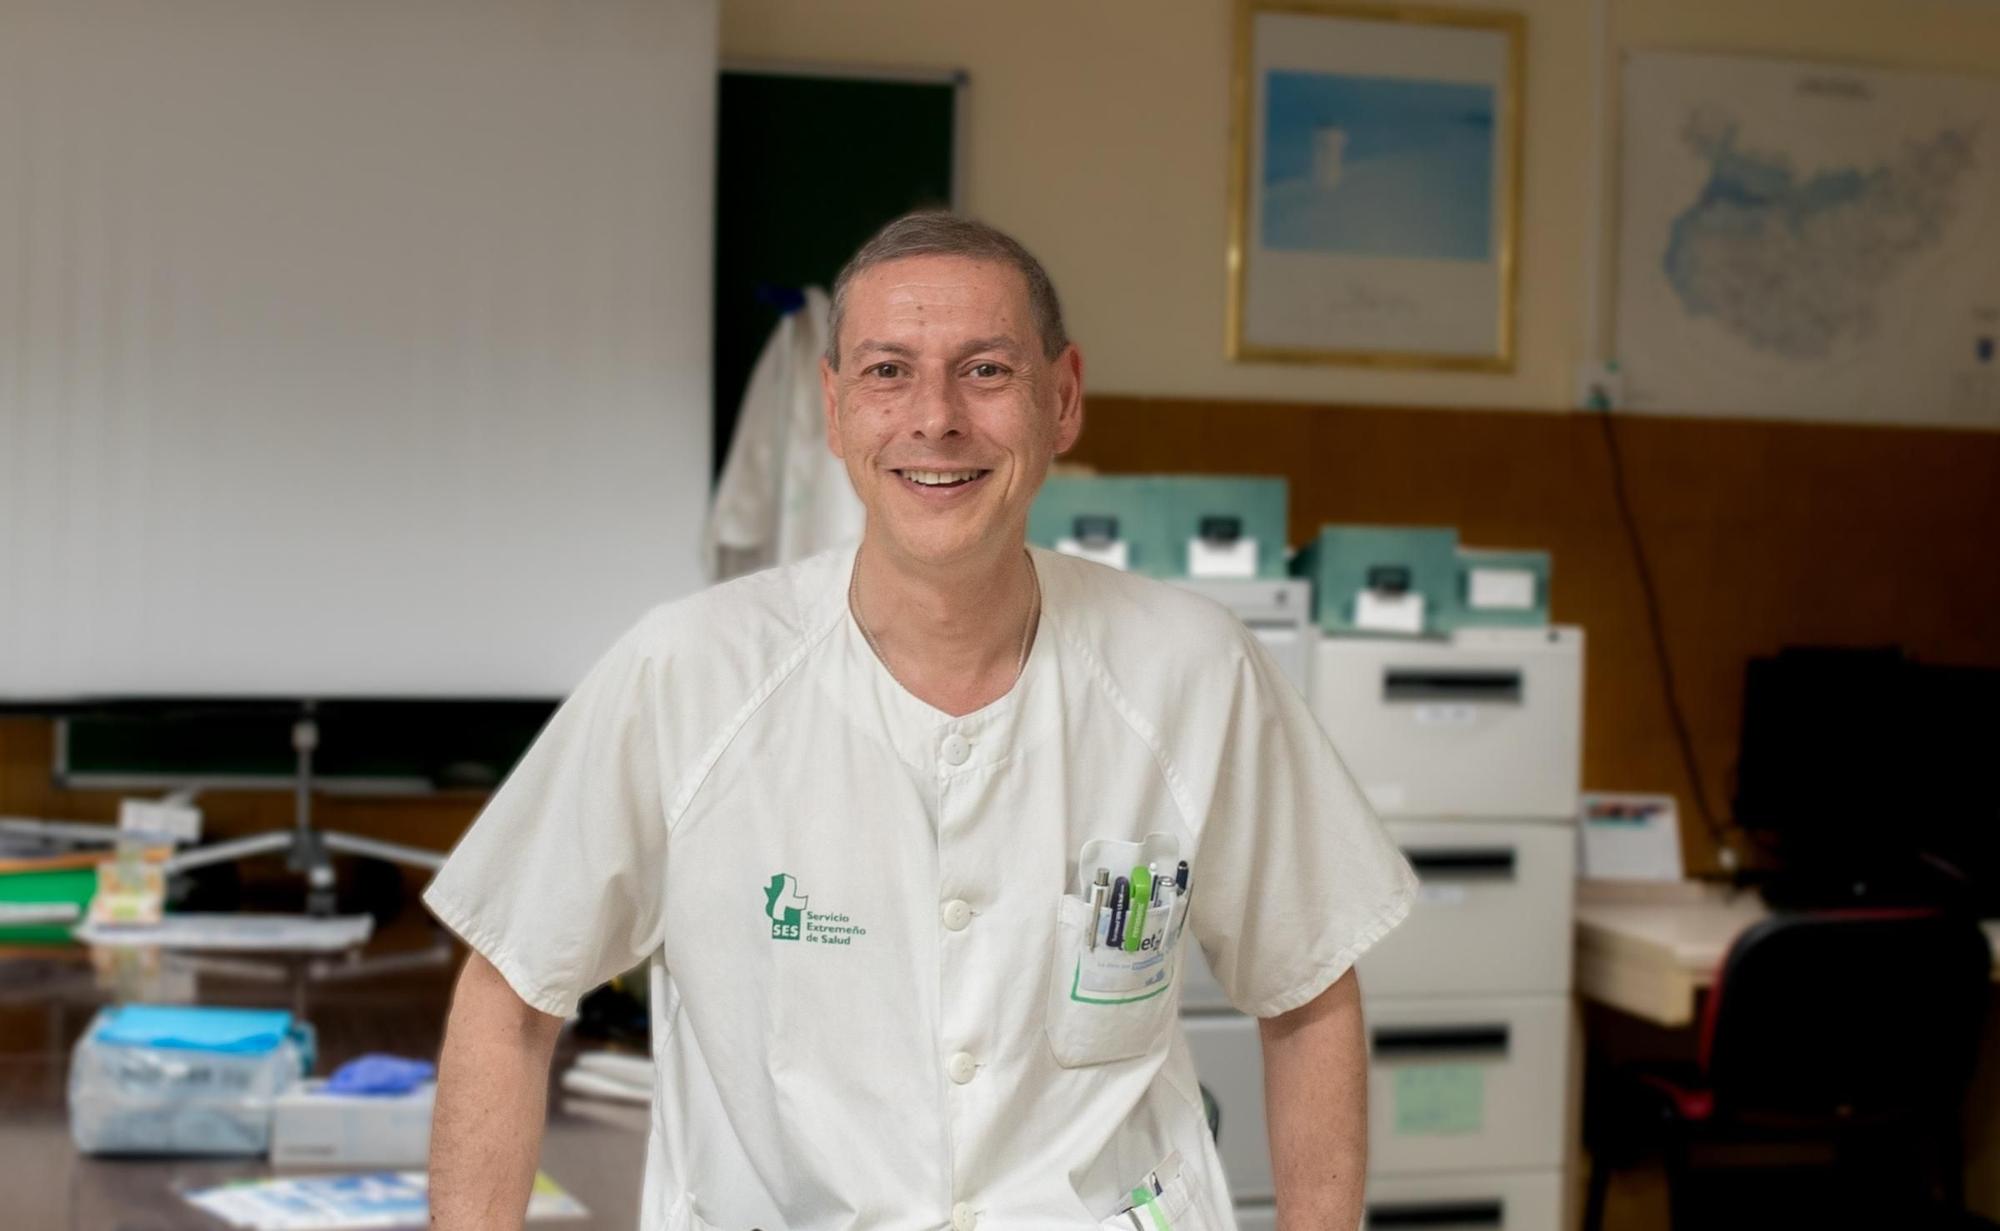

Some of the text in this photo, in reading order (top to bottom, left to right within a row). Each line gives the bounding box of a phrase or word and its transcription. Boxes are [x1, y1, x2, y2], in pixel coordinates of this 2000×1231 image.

[807, 911, 849, 922] Servicio
[773, 924, 799, 937] SES
[807, 922, 866, 935] Extremeño
[807, 933, 851, 945] de Salud
